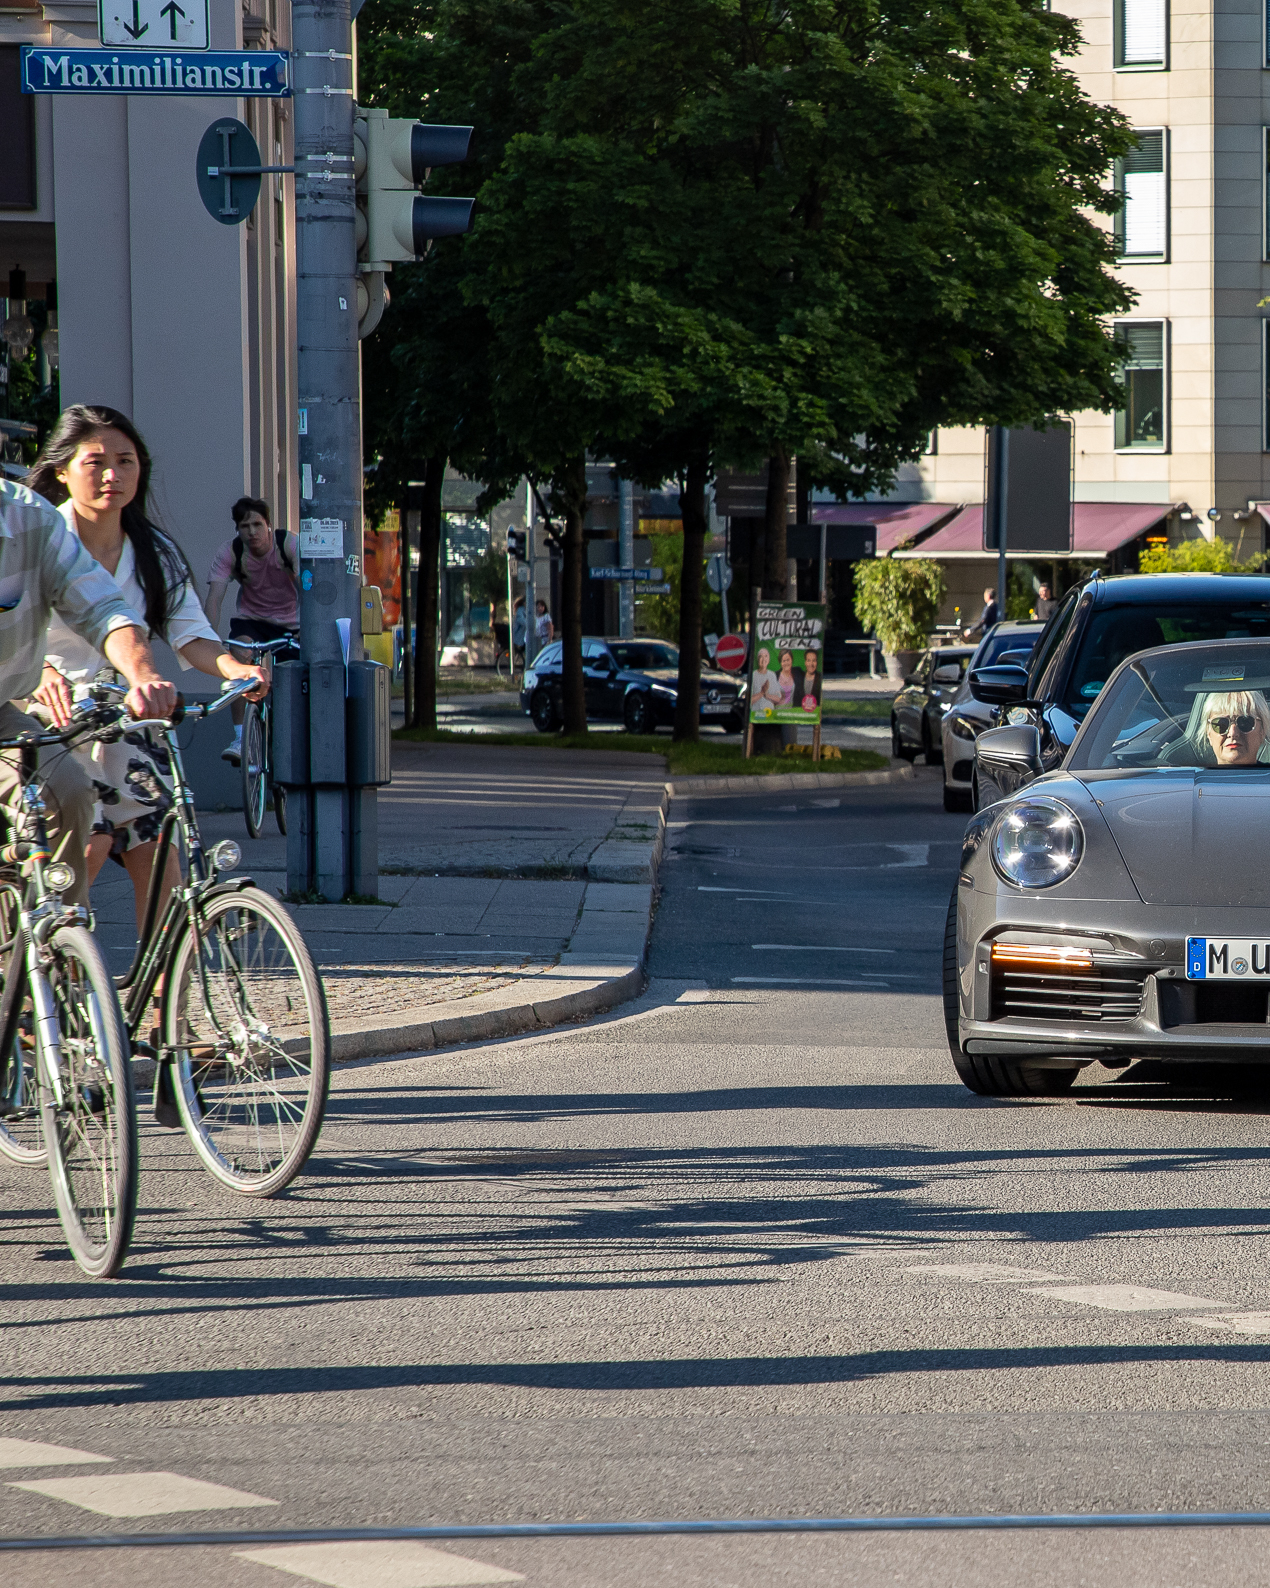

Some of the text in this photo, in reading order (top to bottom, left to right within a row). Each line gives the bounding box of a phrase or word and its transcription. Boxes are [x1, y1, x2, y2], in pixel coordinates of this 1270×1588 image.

[42, 55, 272, 90] Maximilianstr.
[758, 608, 803, 618] GREEN
[761, 620, 817, 639] CULTURAL
[778, 639, 814, 649] DEAL
[302, 681, 308, 693] 3
[1208, 944, 1228, 974] M
[1193, 962, 1201, 972] D
